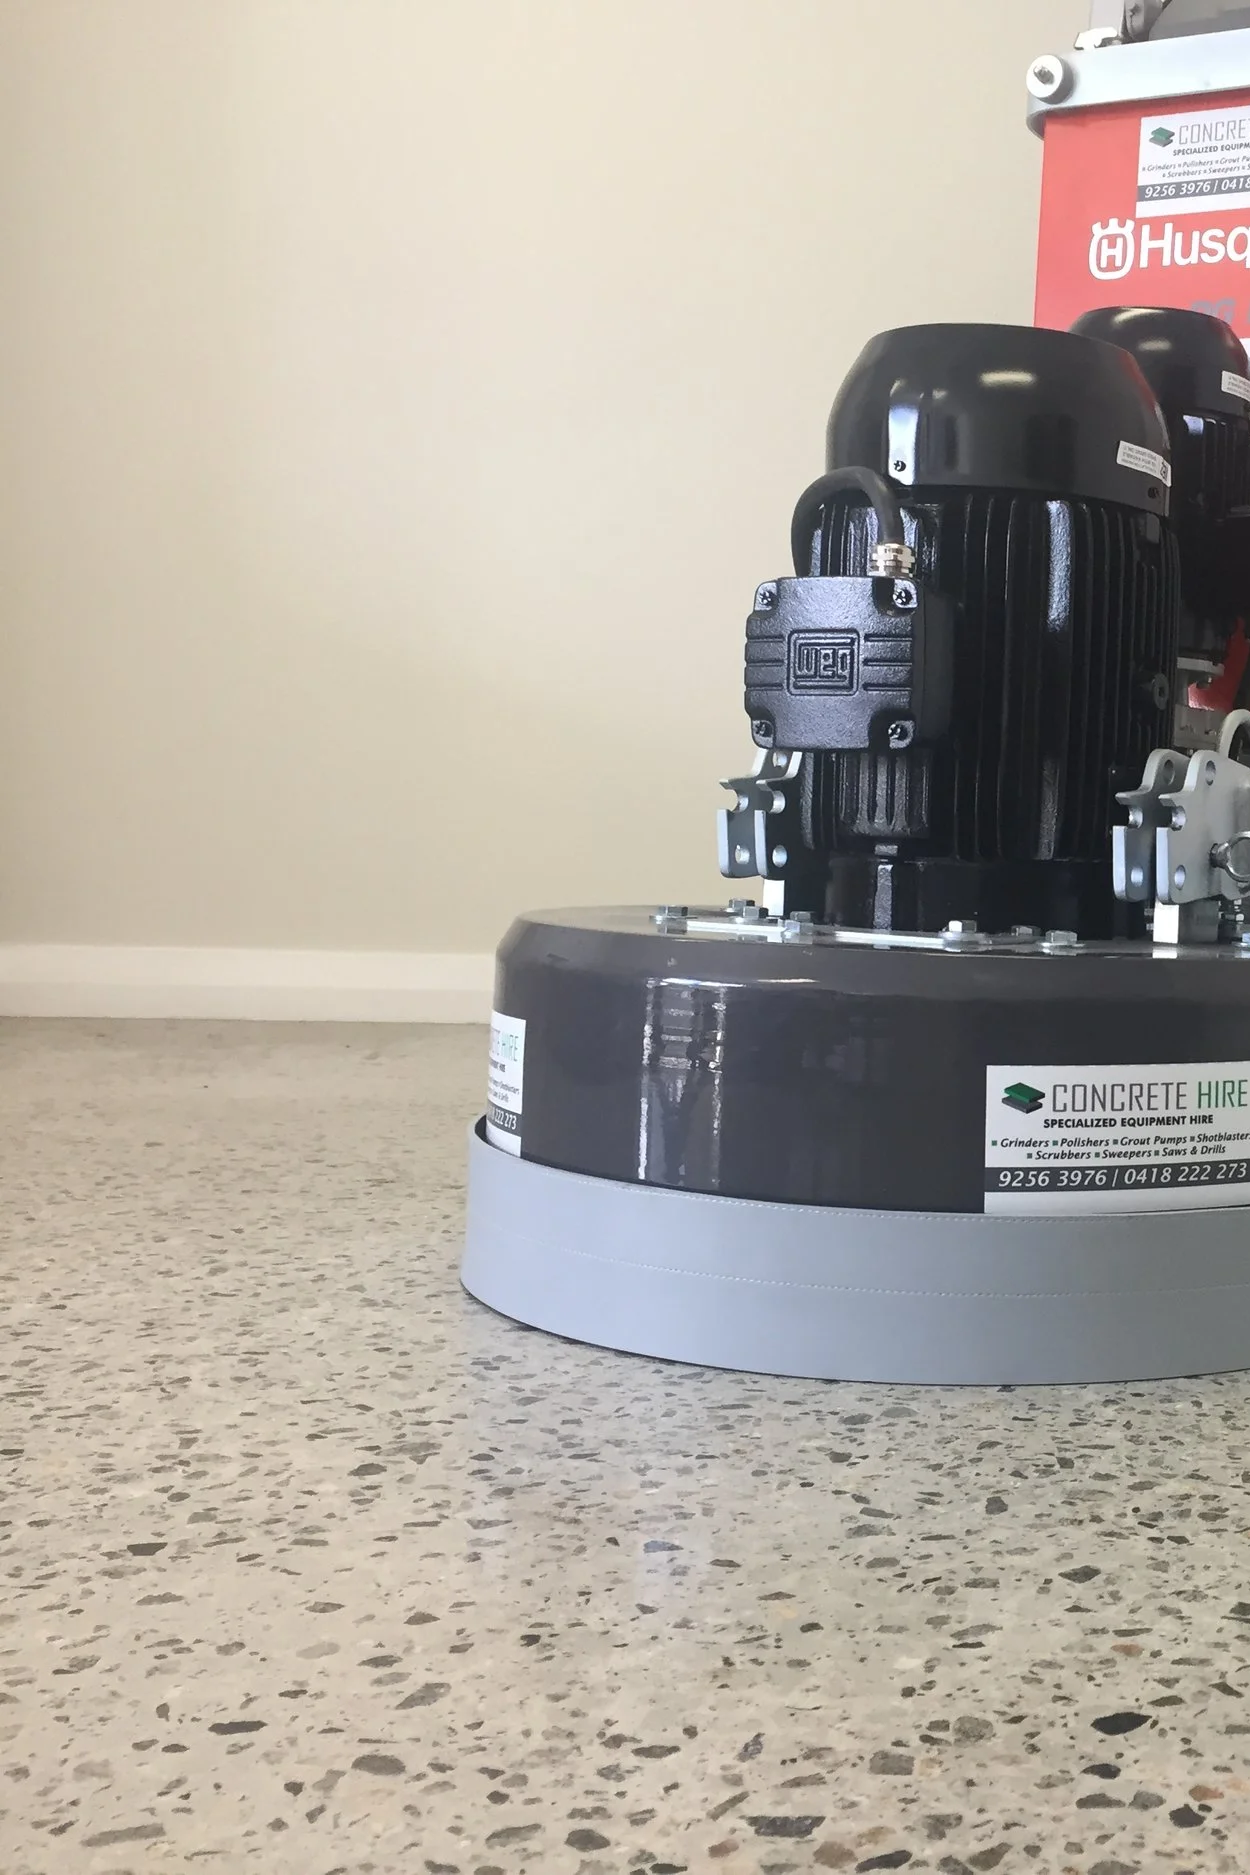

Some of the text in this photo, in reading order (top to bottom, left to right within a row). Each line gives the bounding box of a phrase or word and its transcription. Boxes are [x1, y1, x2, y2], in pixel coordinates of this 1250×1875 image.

[1173, 145, 1219, 156] SPECIALIZED
[1147, 163, 1176, 172] Grinders
[1219, 156, 1240, 165] Grout
[1167, 169, 1202, 178] Scrubbers
[1208, 166, 1240, 175] Sweepers
[1144, 185, 1176, 198] 9256
[1179, 181, 1211, 195] 3976
[1052, 1079, 1249, 1113] CONCRETE HIRE
[504, 1113, 517, 1130] 273
[1043, 1114, 1214, 1129] SPECIALIZED EQUIPMENT HIRE
[1000, 1137, 1049, 1148] Grinders
[1060, 1136, 1110, 1147] Polishers
[1120, 1135, 1151, 1146] Grout
[1154, 1135, 1187, 1147] Pumps
[1035, 1144, 1226, 1160] Scrubbers Sweepers Saws & Drills
[998, 1170, 1050, 1187] 9256
[1056, 1169, 1107, 1187] 3976
[1124, 1166, 1172, 1185] 0418
[1177, 1165, 1210, 1182] 222
[1215, 1162, 1248, 1179] 273
